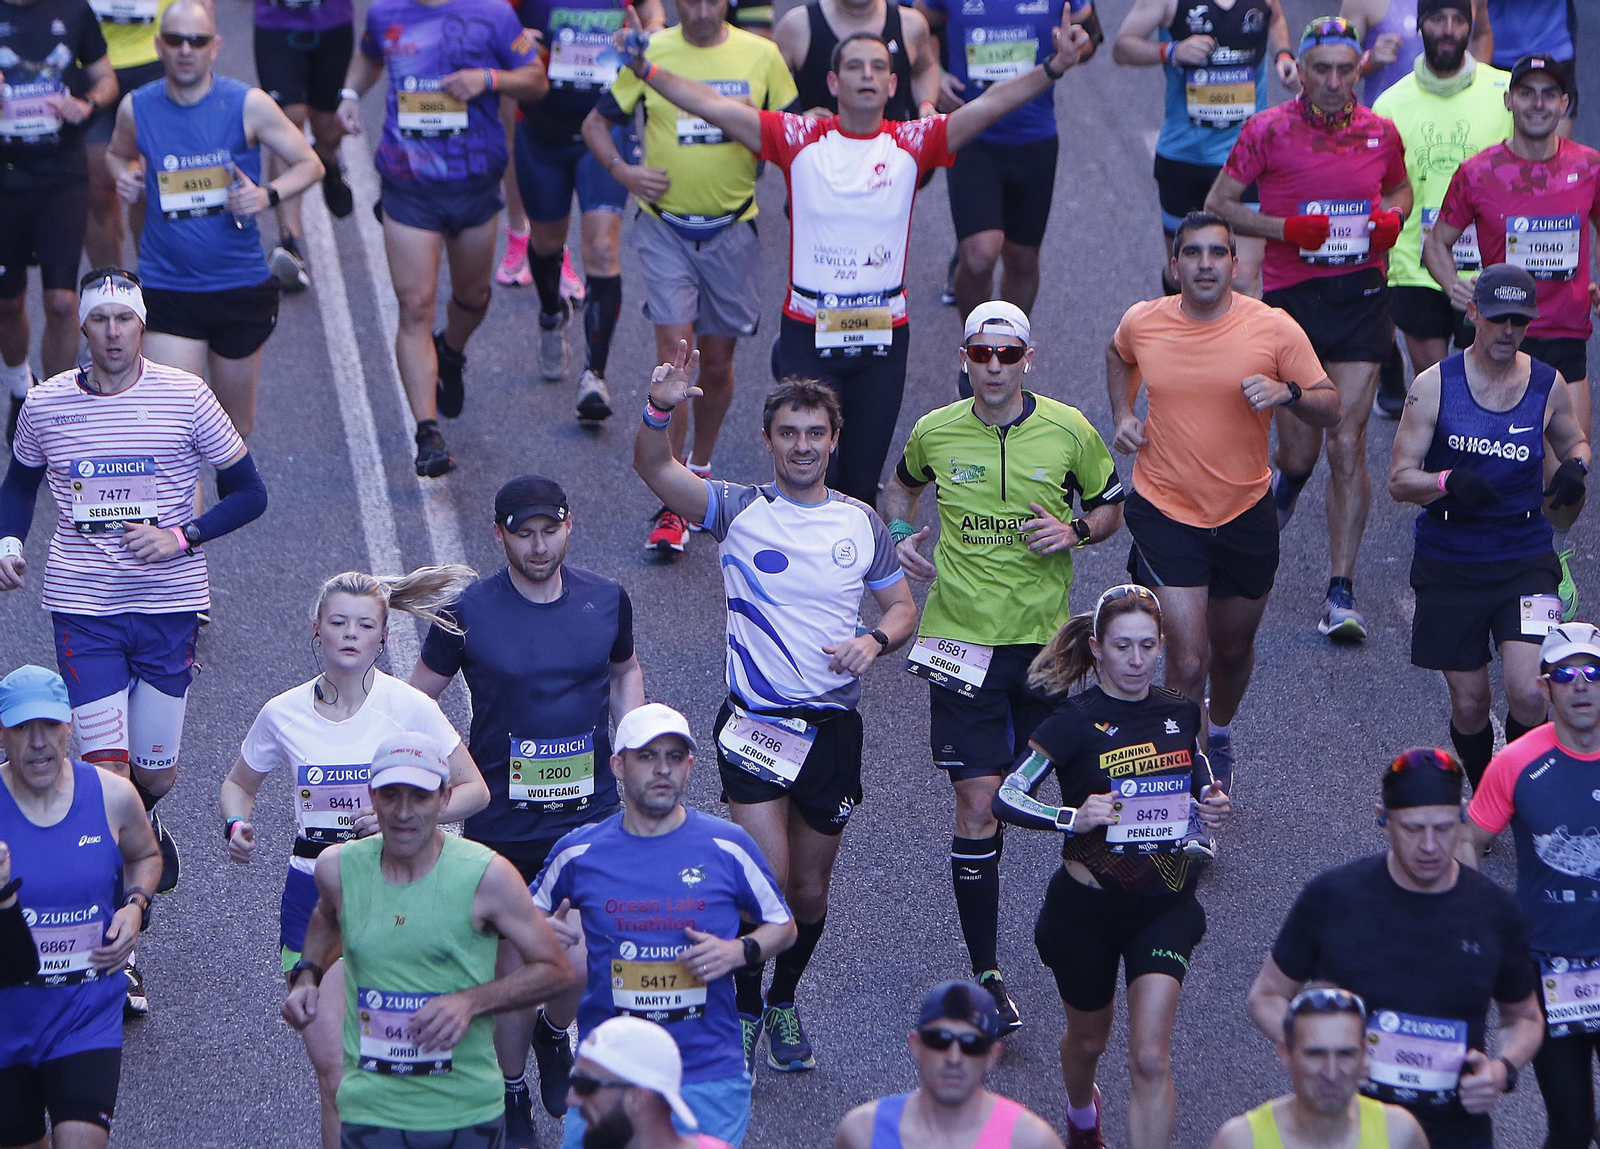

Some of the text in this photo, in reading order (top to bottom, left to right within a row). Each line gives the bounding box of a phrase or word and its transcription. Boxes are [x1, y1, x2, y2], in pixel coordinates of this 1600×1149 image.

[180, 152, 222, 168] ZURICH
[1323, 203, 1363, 215] ZURICH
[1531, 219, 1572, 231] ZURICH
[1332, 227, 1351, 237] 182
[1529, 242, 1564, 253] 10840
[814, 253, 857, 266] SEVILLA
[1525, 258, 1564, 267] CRISTIAN
[833, 268, 857, 279] 2020
[841, 295, 880, 307] ZURICH
[841, 318, 868, 329] 5294
[843, 334, 864, 342] EMIR
[1448, 434, 1530, 462] CHICAGO
[97, 461, 145, 474] ZURICH
[98, 488, 131, 501] 7477
[89, 506, 141, 517] SEBASTIAN
[962, 532, 1014, 546] Running
[937, 639, 968, 659] 6581
[929, 655, 961, 674] SERGIO
[540, 739, 585, 755] ZURICH
[751, 730, 782, 753] 6786
[739, 744, 776, 768] JEROME
[1105, 745, 1151, 765] TRAINING
[1113, 753, 1190, 776] FOR VALENCIA
[538, 767, 571, 779] 1200
[528, 786, 580, 798] WOLFGANG
[1140, 780, 1183, 793] ZURICH
[329, 797, 361, 809] 8441
[1136, 808, 1168, 821] 8479
[605, 896, 706, 914] Ocean Lake
[41, 909, 92, 924] ZURICH
[614, 917, 697, 932] Triathlon
[40, 939, 76, 953] 6867
[43, 959, 70, 970] MAXI
[640, 975, 677, 989] 5417
[386, 997, 428, 1010] ZURIC
[634, 995, 682, 1006] MARTY B
[1401, 1019, 1455, 1039] ZURICH
[388, 1046, 418, 1058] JORDI
